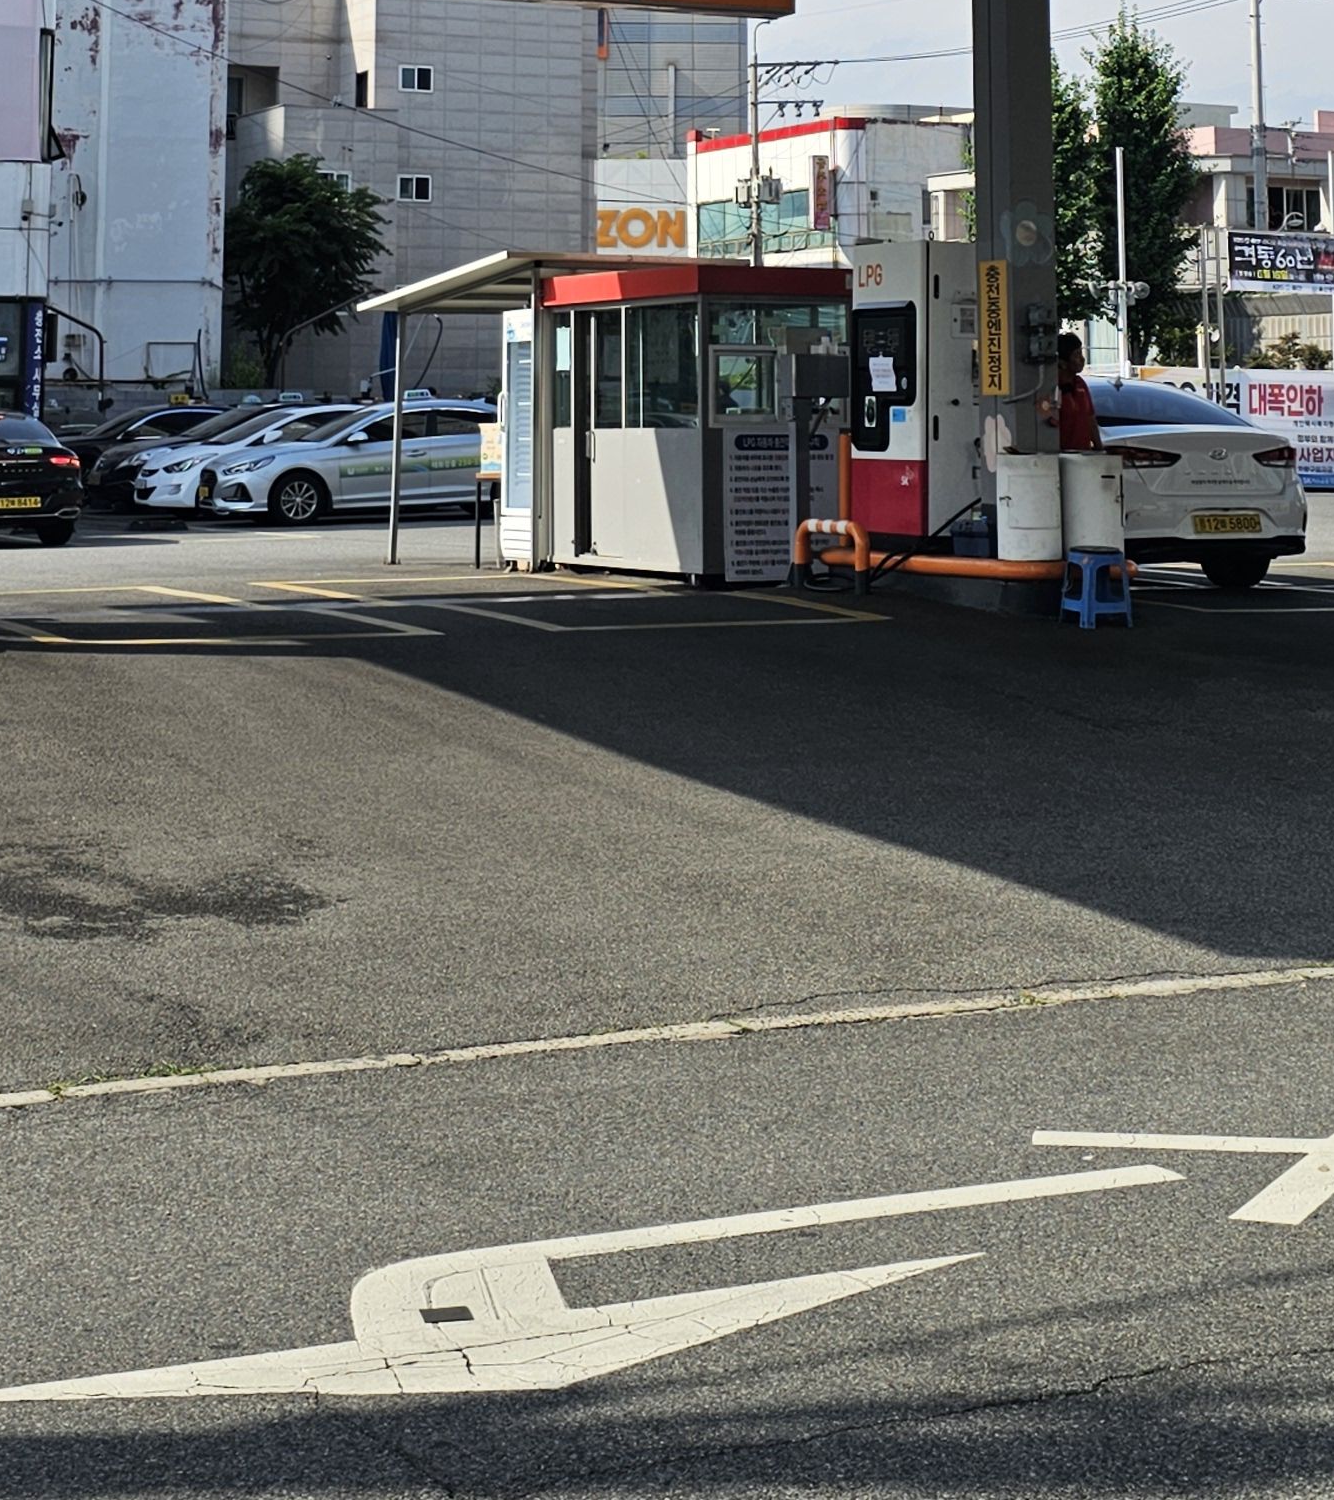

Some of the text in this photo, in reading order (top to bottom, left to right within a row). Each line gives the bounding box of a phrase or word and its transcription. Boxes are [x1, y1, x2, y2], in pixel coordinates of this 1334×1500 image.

[859, 263, 883, 288] LPG
[984, 264, 1003, 391] 충전중엔진정지
[1249, 383, 1324, 417] 대폭인하
